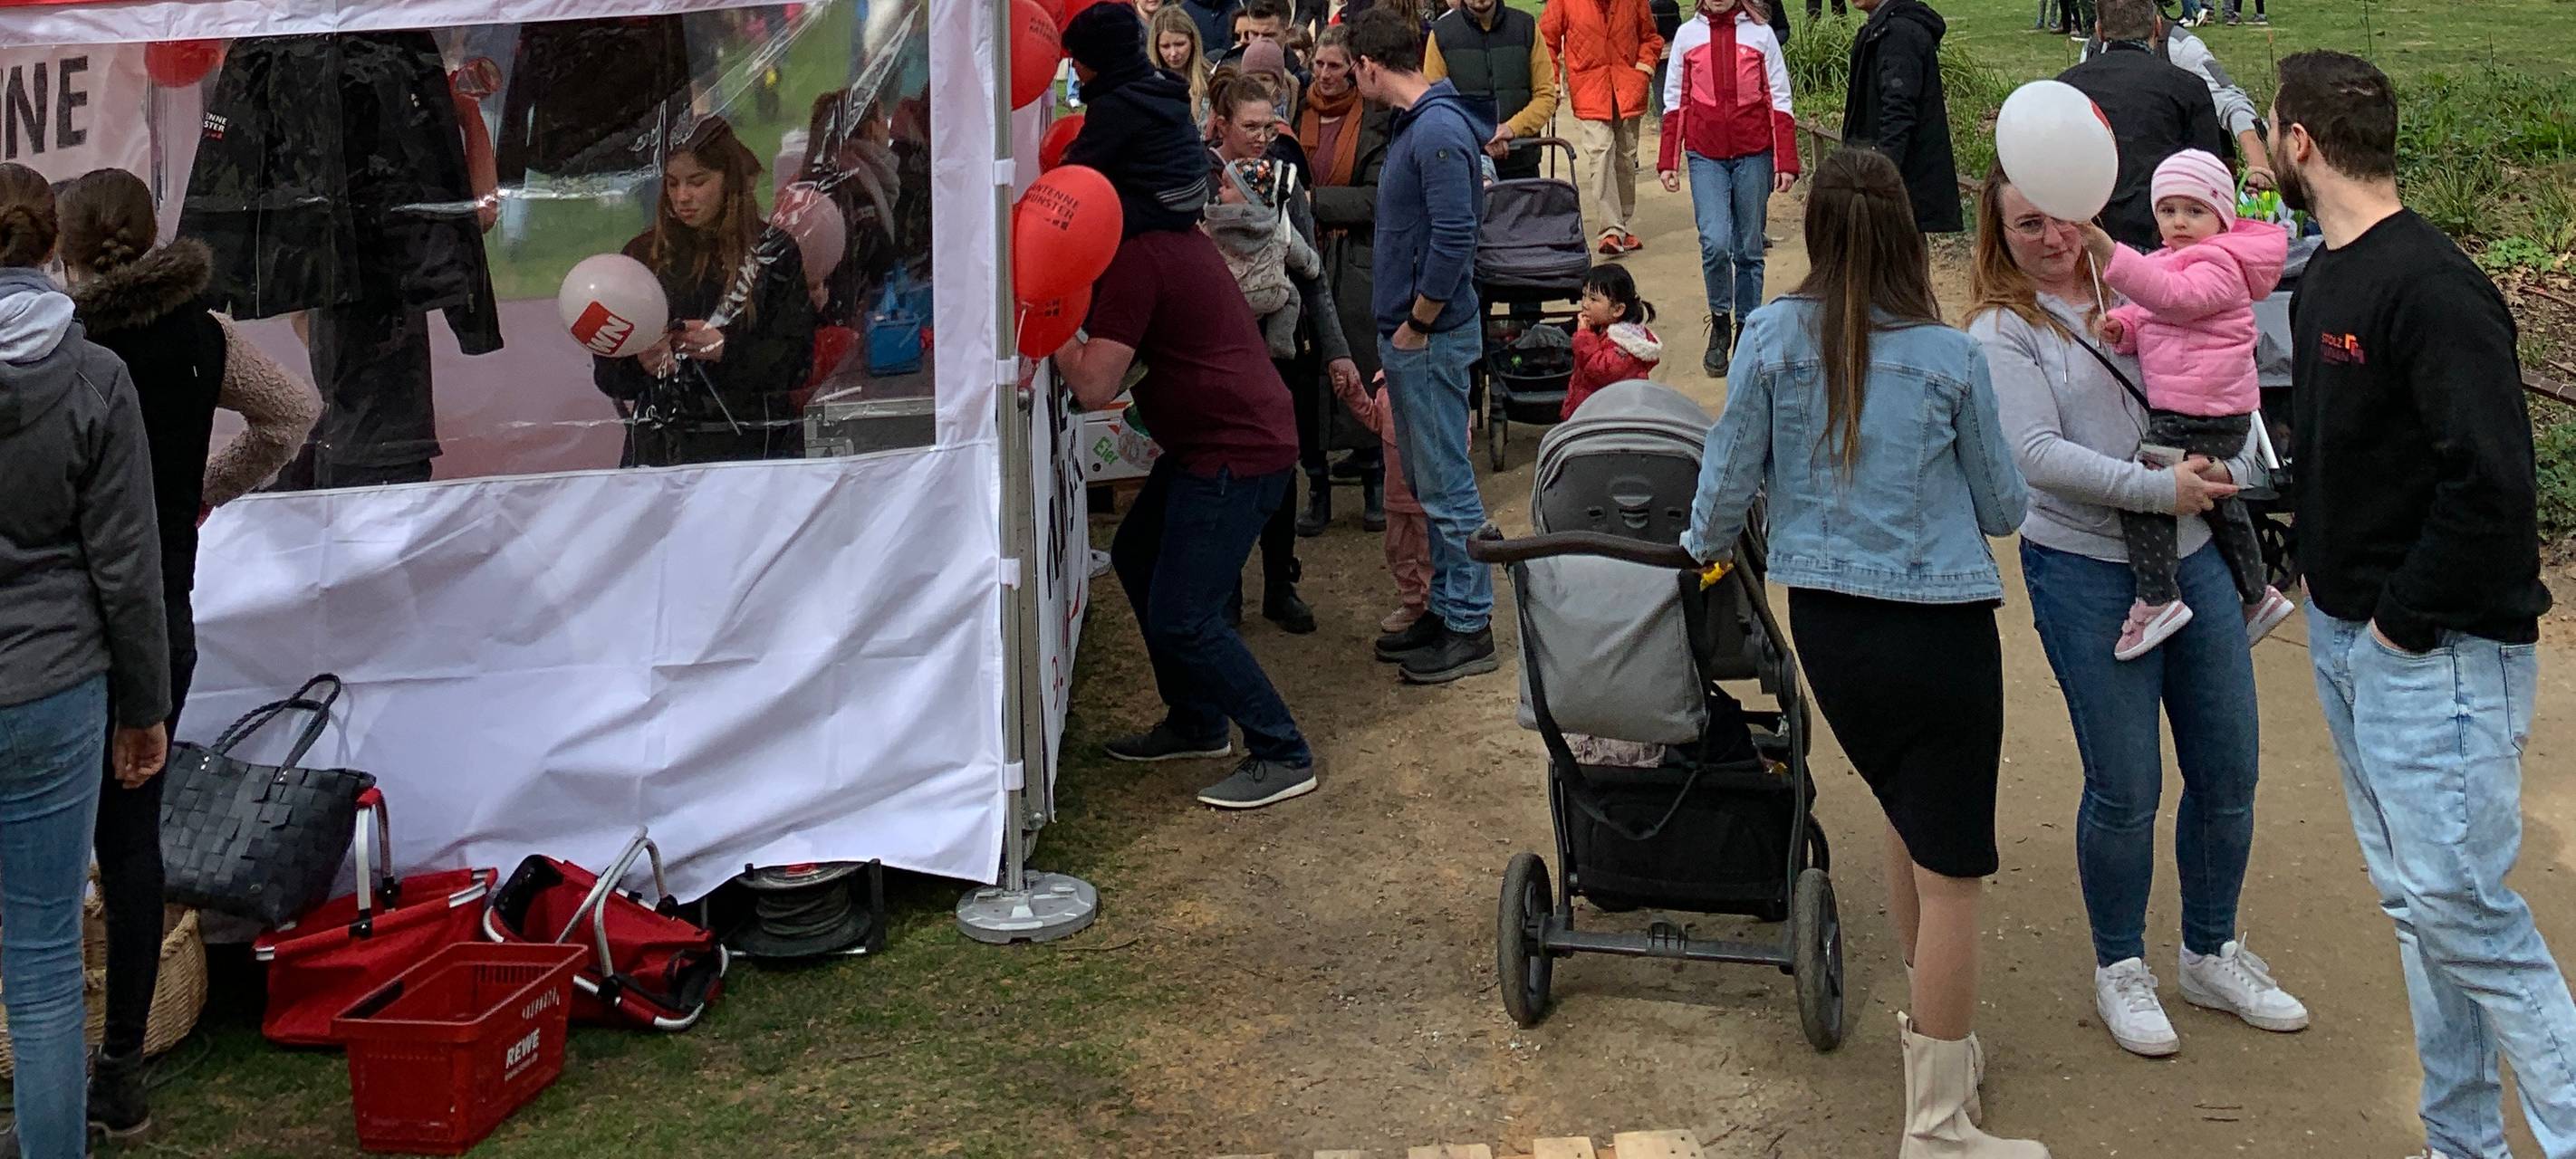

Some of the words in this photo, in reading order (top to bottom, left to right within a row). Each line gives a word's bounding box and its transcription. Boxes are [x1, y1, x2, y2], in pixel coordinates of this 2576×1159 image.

[0, 55, 88, 160] NE
[1092, 436, 1120, 465] Eier
[505, 1027, 541, 1069] REWE
